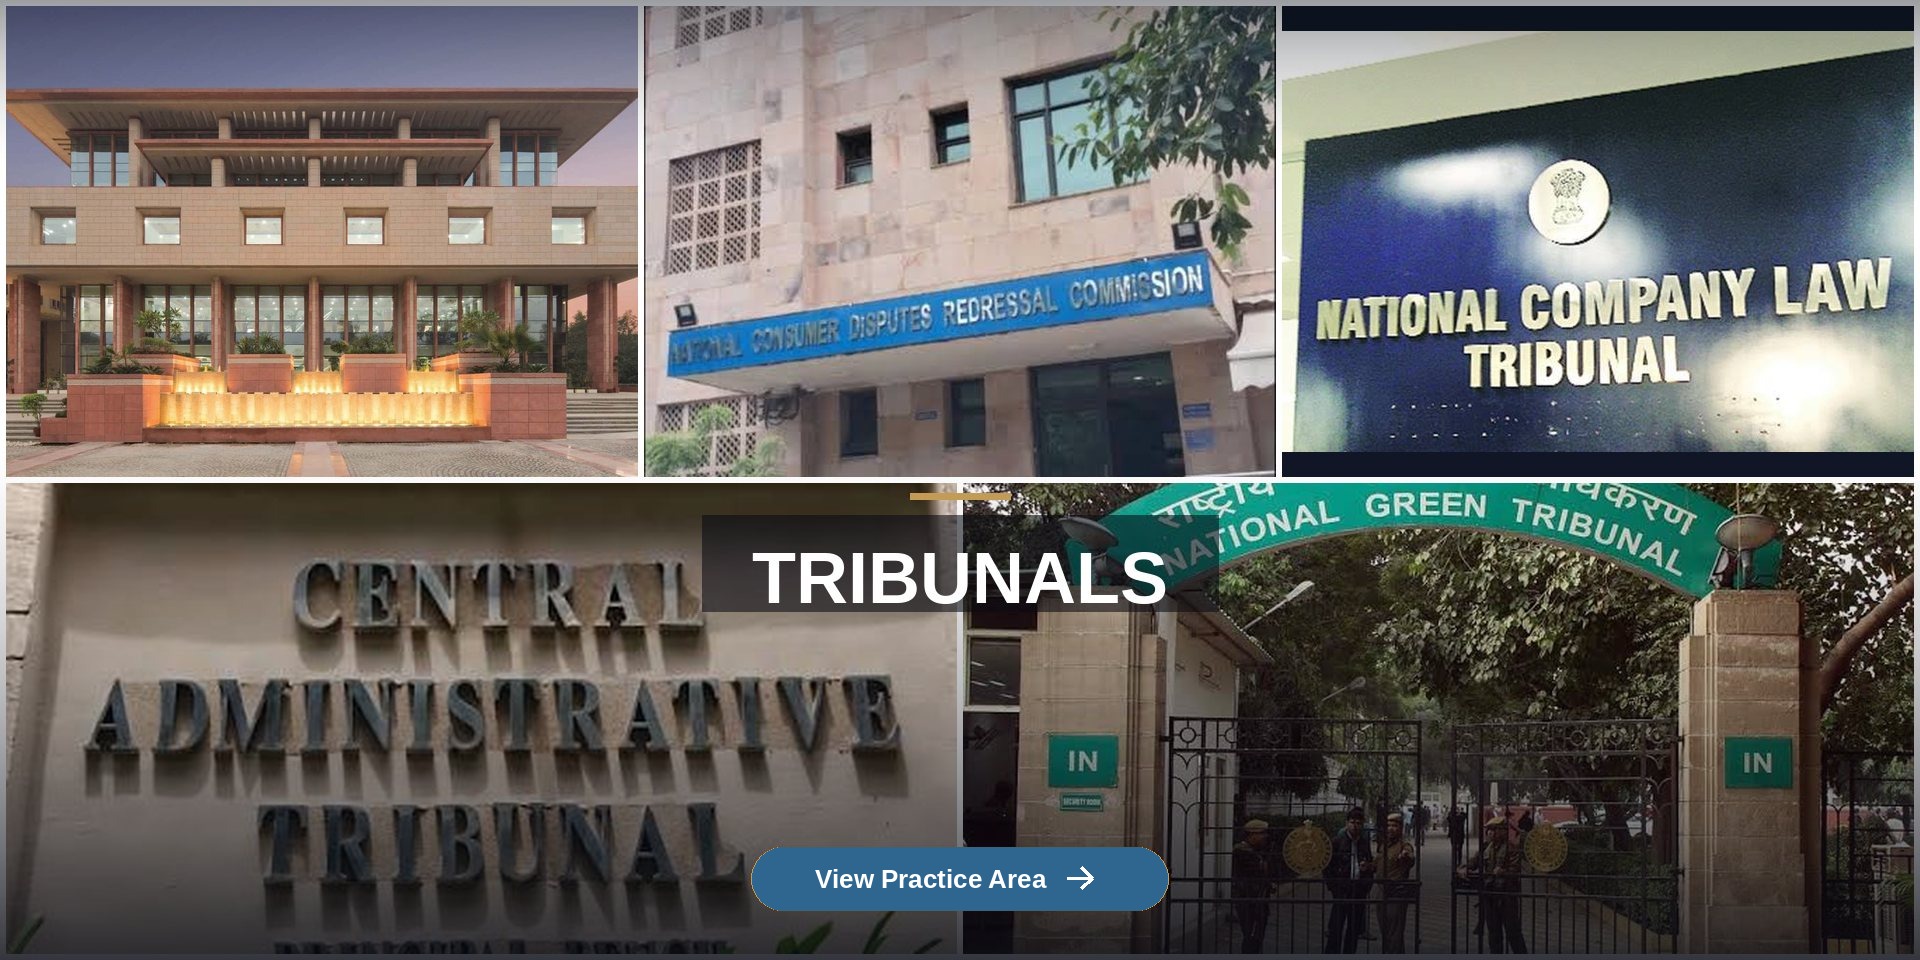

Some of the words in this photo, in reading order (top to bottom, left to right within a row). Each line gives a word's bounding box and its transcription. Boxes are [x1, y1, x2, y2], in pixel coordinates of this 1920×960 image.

[752, 317, 839, 353] CONSUMER
[850, 303, 933, 342] DISPUTES
[943, 285, 1059, 326] REDRESSAL
[1070, 264, 1204, 309] COMMISSION
[1316, 288, 1507, 340] NATIONAL
[1520, 268, 1755, 331] COMPANY
[1774, 257, 1893, 314] LAW
[1463, 335, 1691, 388] TRIBUNAL
[1162, 499, 1340, 576] NATIONAL
[1365, 491, 1486, 519] GREEN
[1512, 498, 1683, 577] TRIBUNAL
[292, 557, 704, 633] CENTRAL
[84, 674, 903, 756] ADMINISTRATIVE
[1068, 750, 1098, 772] IN
[1743, 752, 1773, 774] IN
[257, 801, 745, 888] TRIBUNAL
